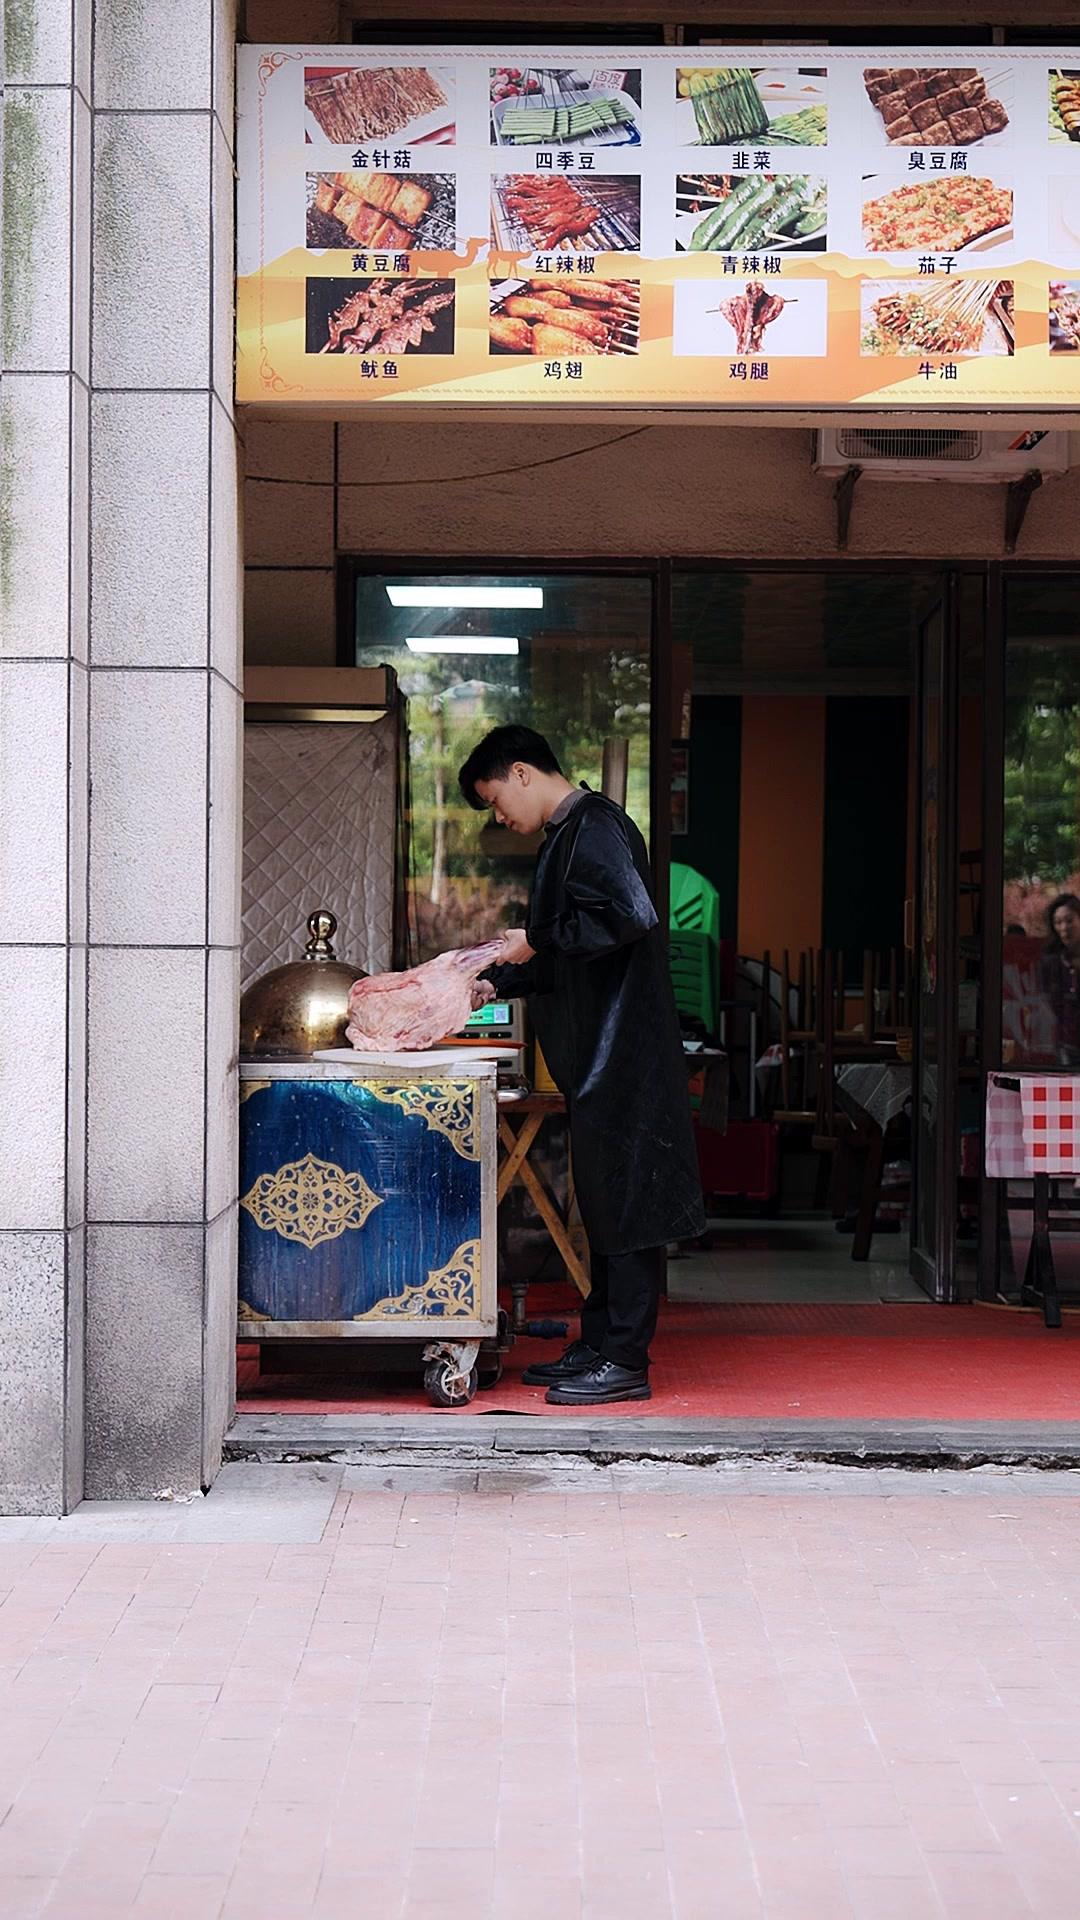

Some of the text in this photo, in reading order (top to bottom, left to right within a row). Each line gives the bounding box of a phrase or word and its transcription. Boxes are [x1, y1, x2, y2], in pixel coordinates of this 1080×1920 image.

[351, 149, 411, 169] 金针菇
[536, 151, 596, 171] 四季豆
[732, 150, 771, 170] 韭菜
[908, 151, 968, 171] 臭豆腐
[351, 253, 411, 273] 黄豆腐
[535, 255, 595, 274] 红辣椒
[721, 255, 781, 275] 青辣椒
[918, 256, 958, 275] 茄子
[360, 359, 399, 379] 鱿鱼
[543, 360, 583, 380] 鸡翅
[729, 361, 769, 381] 鸡腿
[917, 361, 957, 380] 牛油
